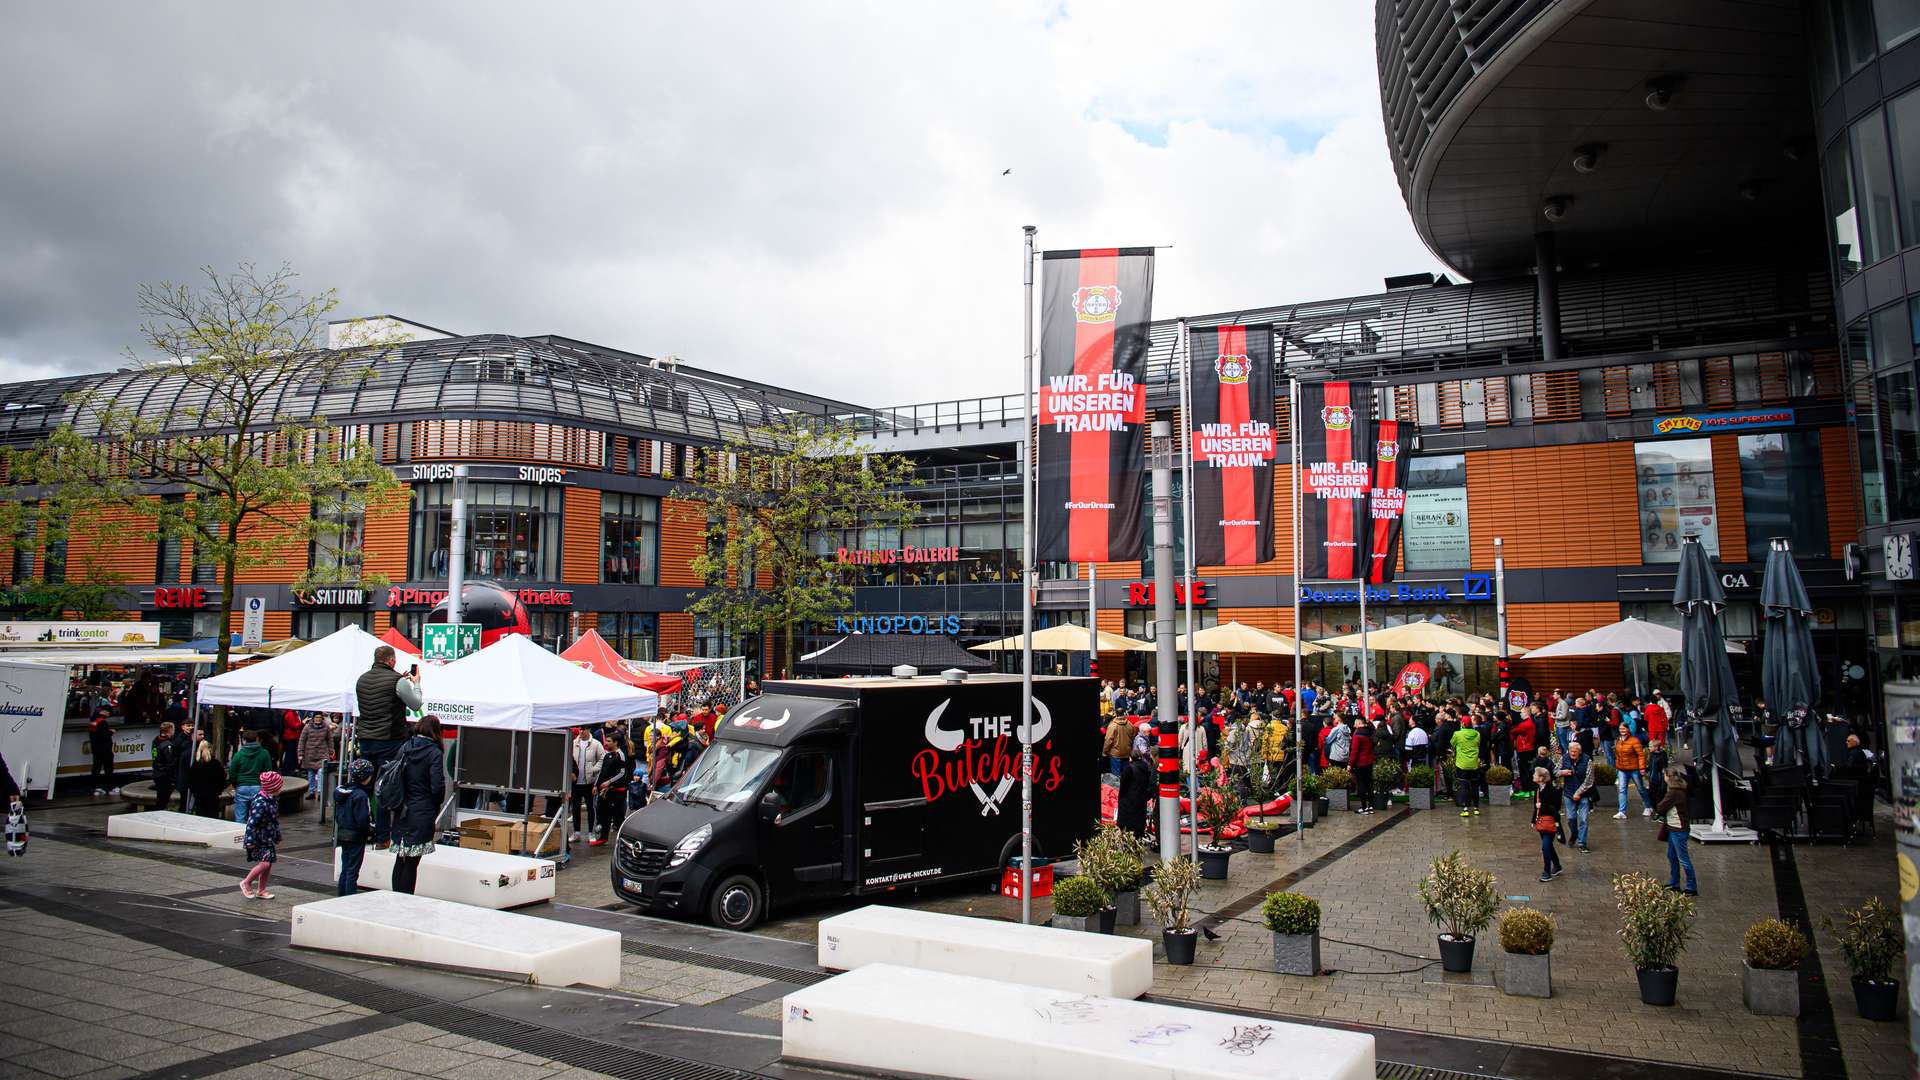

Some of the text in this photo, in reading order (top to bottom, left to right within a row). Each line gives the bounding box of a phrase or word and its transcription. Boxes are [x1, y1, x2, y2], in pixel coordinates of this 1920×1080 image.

[1050, 370, 1134, 393] WIR. FÜR
[1048, 393, 1134, 414] UNSEREN
[1053, 413, 1128, 433] TRAUM.
[1201, 420, 1270, 438] WIR. FÜR
[1657, 418, 1702, 433] SMYTHS
[1705, 418, 1728, 427] TOYS
[1201, 437, 1272, 453] UNSEREN
[1206, 453, 1267, 468] TRAUM.
[1310, 460, 1368, 474] WIR. FÜR
[1310, 474, 1368, 487] UNSEREN
[1315, 487, 1364, 500] TRAUM.
[1065, 501, 1115, 510] #ForOurDream
[1372, 510, 1399, 519] RAUM.
[838, 545, 959, 565] RATHAUS-GALERIE
[154, 587, 206, 608] REWE
[316, 589, 363, 605] SATURN
[403, 588, 449, 608] Ping
[518, 588, 571, 605] theke
[1398, 584, 1451, 601] Bank
[836, 615, 961, 635] KINOPOLIS
[427, 702, 475, 715] BERGISCHE
[969, 715, 1012, 739] THE
[112, 742, 145, 754] burger
